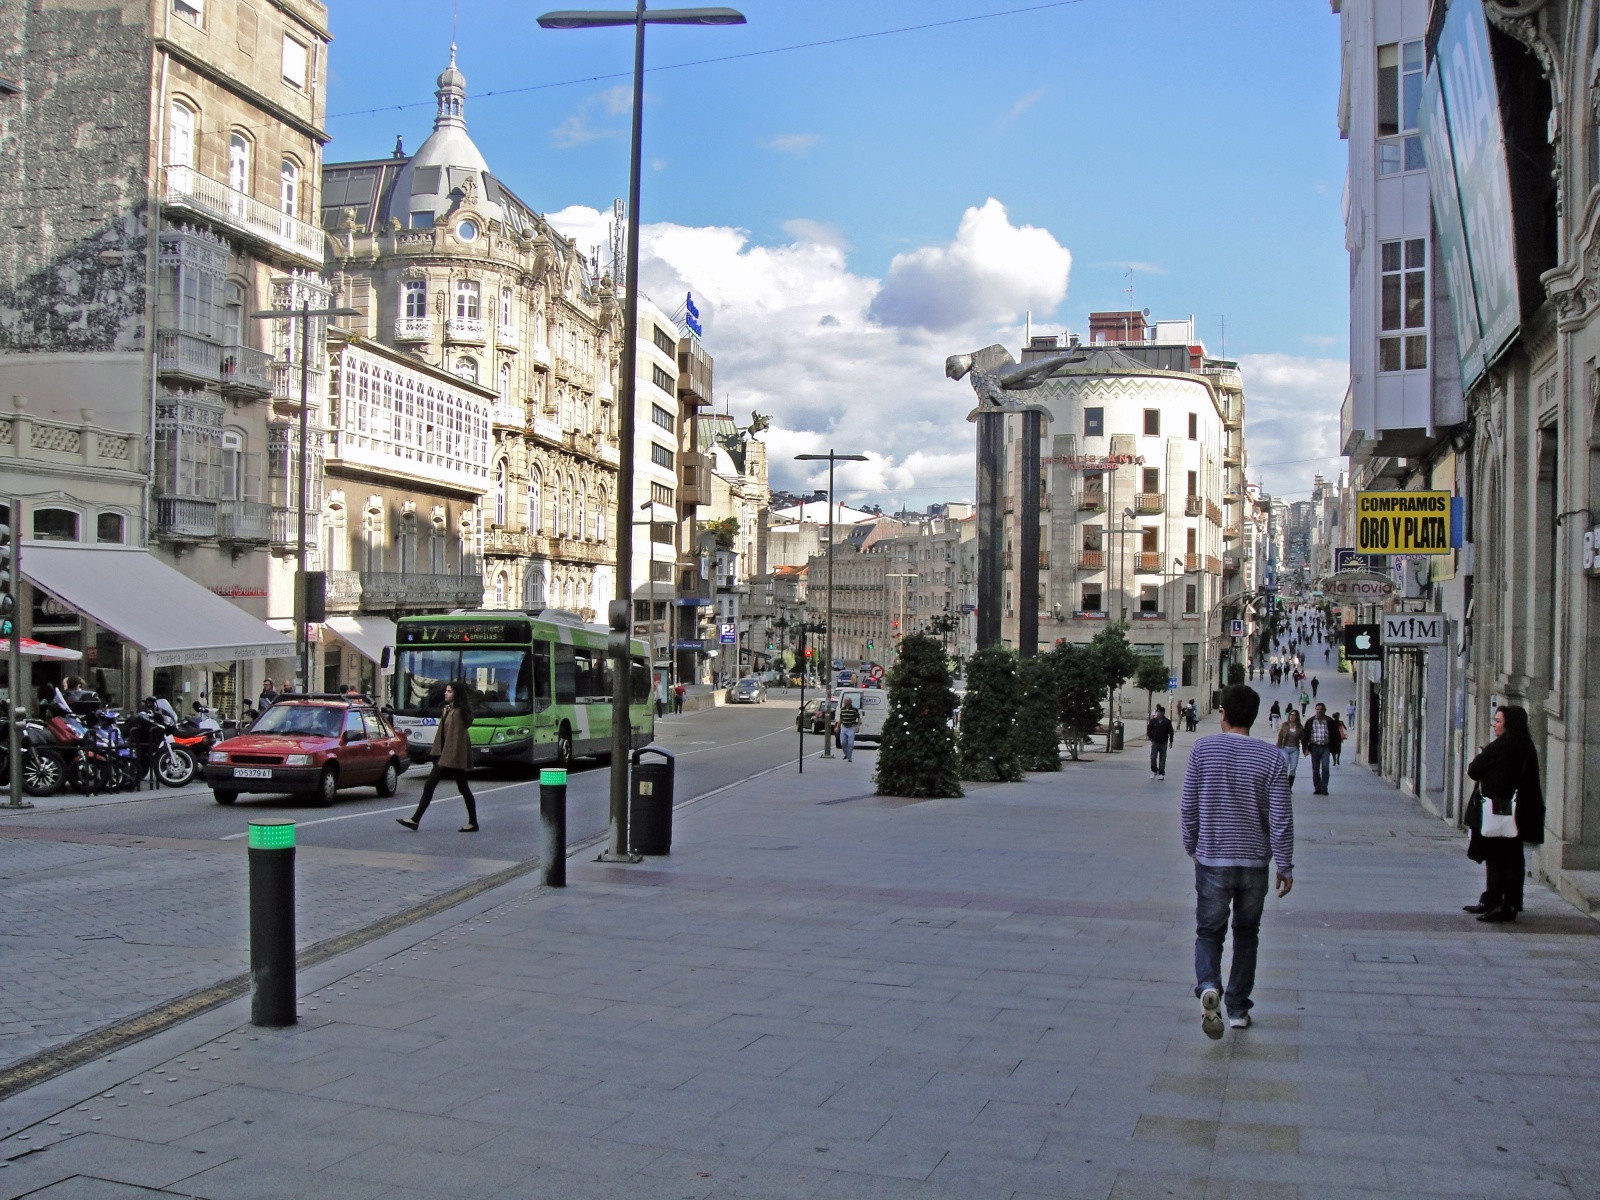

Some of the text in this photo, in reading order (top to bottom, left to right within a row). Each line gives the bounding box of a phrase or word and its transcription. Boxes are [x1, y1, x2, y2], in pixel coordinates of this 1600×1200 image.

[1361, 497, 1446, 512] COMPRAMOS
[1360, 516, 1447, 549] ORO Y PLATA
[1351, 580, 1393, 594] novia
